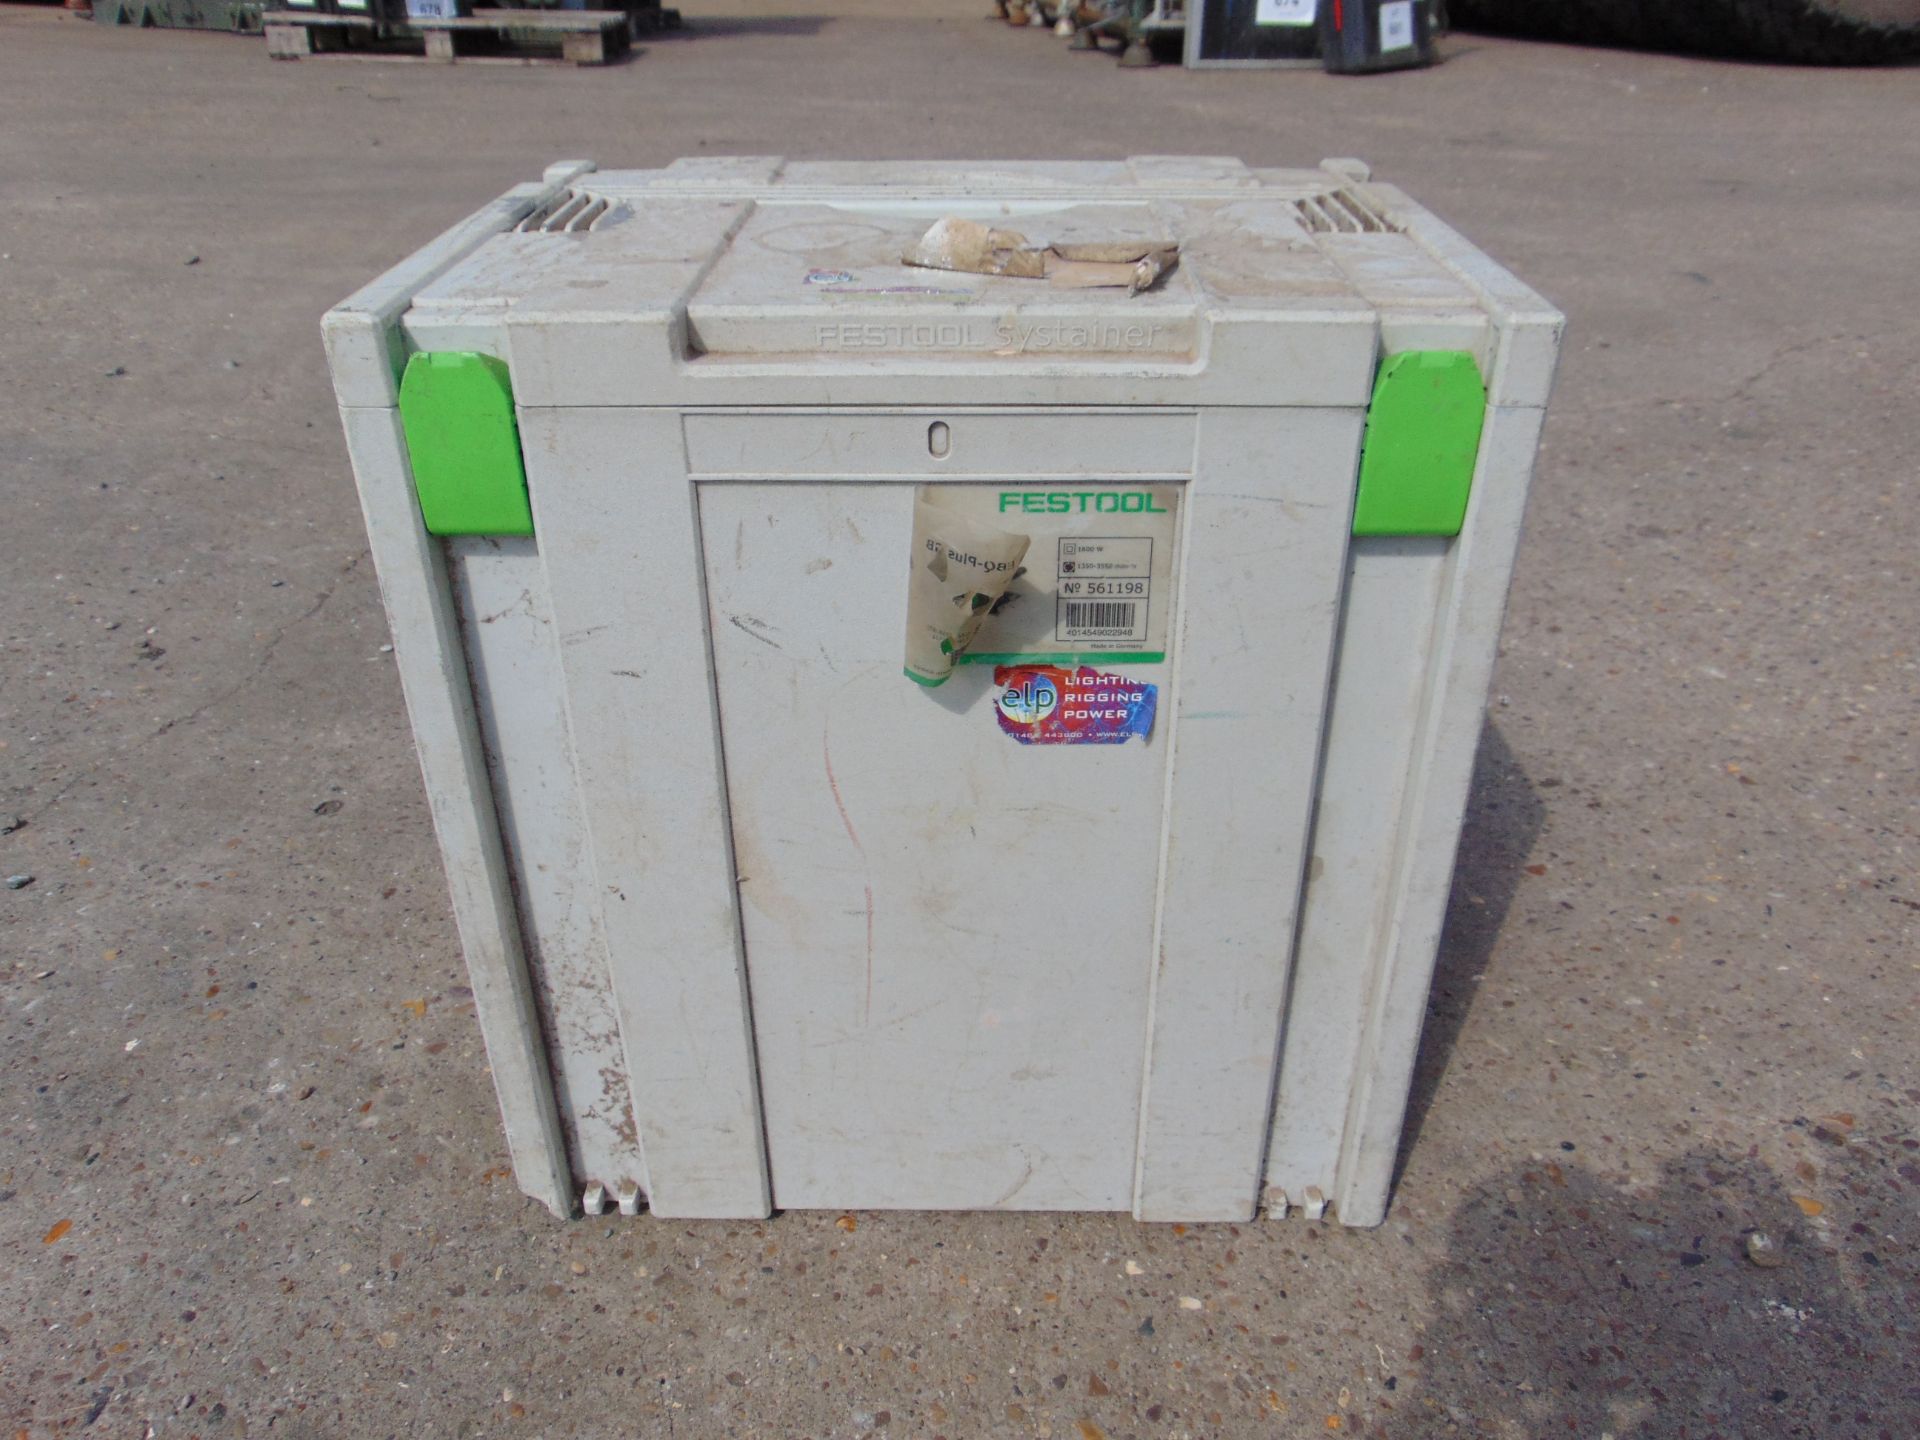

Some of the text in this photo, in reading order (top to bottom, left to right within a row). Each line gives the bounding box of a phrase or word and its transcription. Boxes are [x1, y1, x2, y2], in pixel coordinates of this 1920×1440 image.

[814, 319, 1160, 353] FESTOOL systainer
[998, 491, 1168, 514] FESTOOL
[1087, 582, 1144, 595] 561198
[1066, 627, 1134, 637] 4014549022948
[1064, 675, 1149, 686] LIGHTIN
[1001, 681, 1055, 714] elp
[1064, 692, 1143, 703] RIGGING
[1064, 709, 1128, 720] POWER
